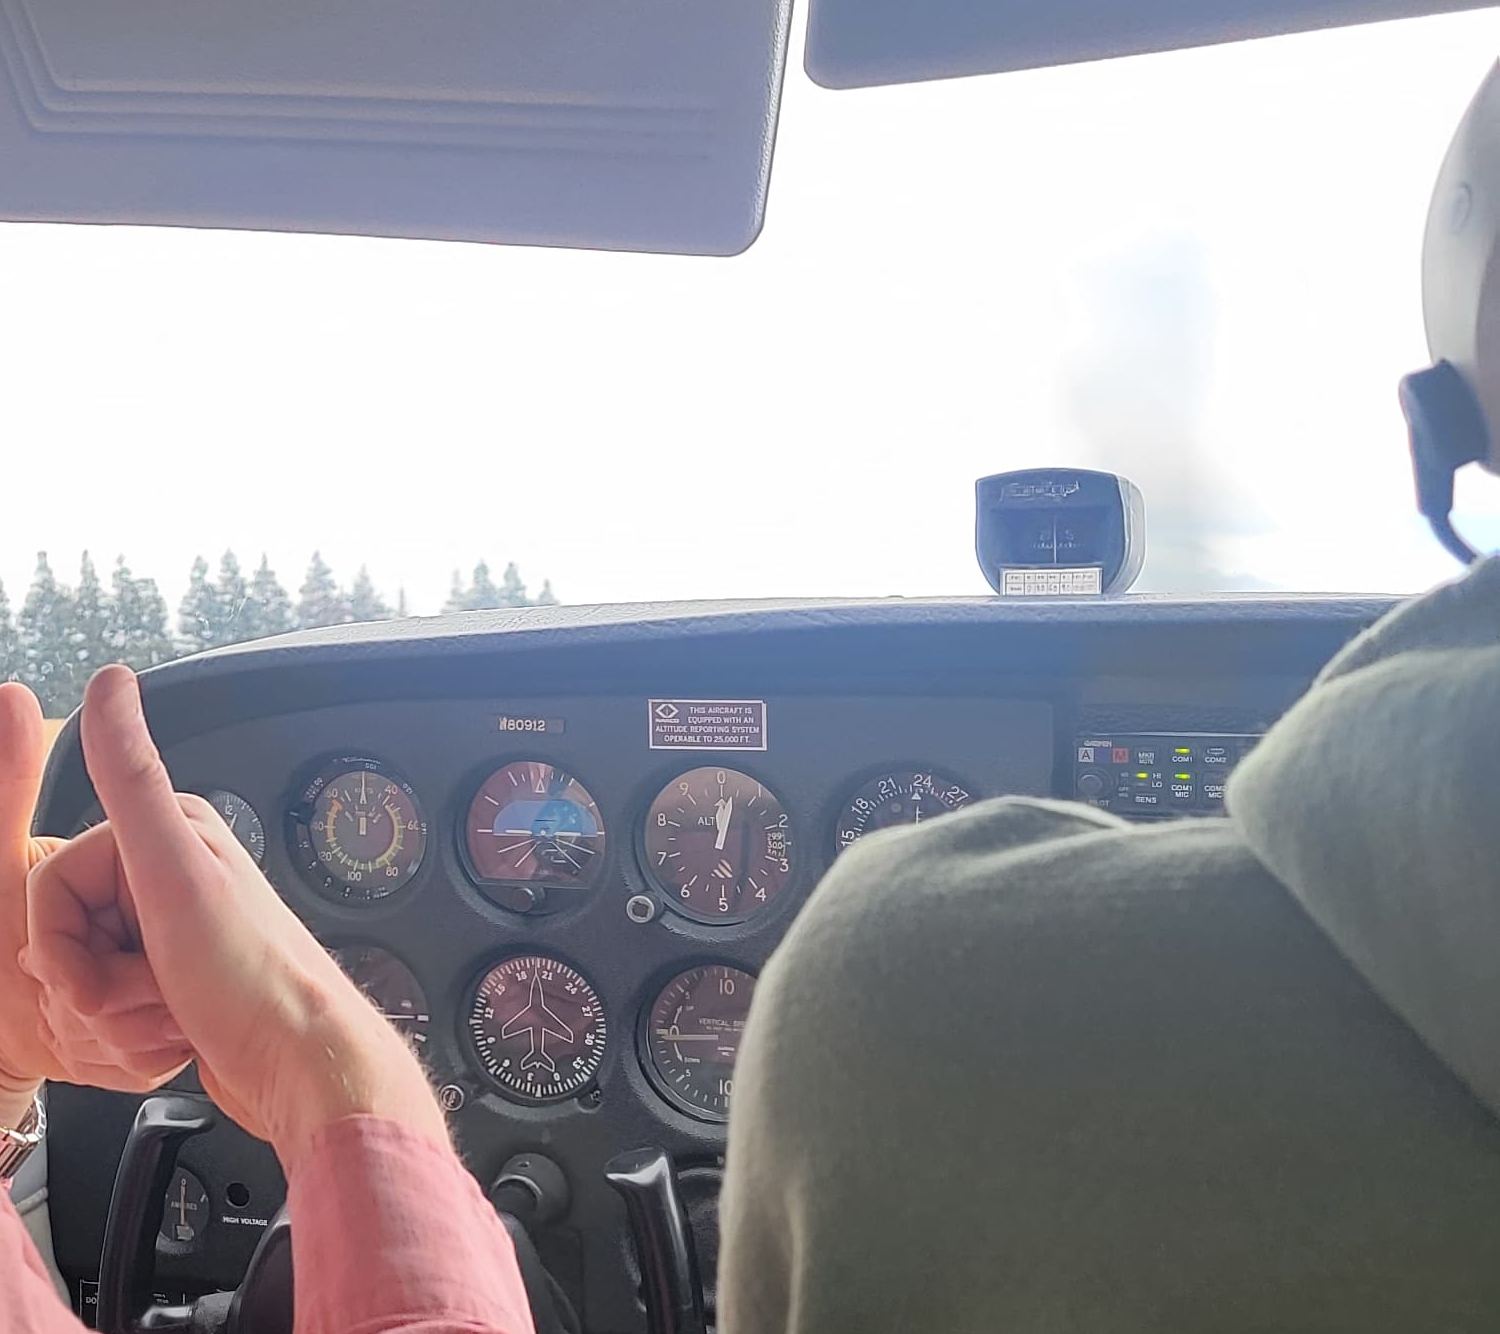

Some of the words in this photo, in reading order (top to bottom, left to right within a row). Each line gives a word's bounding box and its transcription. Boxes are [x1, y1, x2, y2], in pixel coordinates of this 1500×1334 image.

[690, 706, 706, 714] THIS
[708, 706, 742, 714] AIRCRAFT
[687, 716, 722, 725] EQUIPPED
[655, 725, 688, 733] ALTITUDE
[731, 726, 760, 734] SYSTEM
[663, 734, 701, 742] OPERABLE
[703, 735, 712, 743] TO
[1172, 755, 1193, 763] COM1
[716, 770, 727, 784] 0
[913, 774, 933, 788] 24
[383, 784, 398, 795] 40
[678, 782, 689, 796] 9
[878, 777, 897, 794] 21
[1152, 780, 1163, 788] LO
[1171, 784, 1193, 792] COM1
[947, 785, 969, 802] 27
[1135, 796, 1157, 804] SENS
[851, 797, 869, 815] 18
[407, 819, 419, 831] 60
[657, 812, 667, 827] 8
[697, 816, 715, 826] ALT
[778, 814, 789, 828] 2
[840, 829, 855, 848] 15
[657, 851, 667, 865] 7
[386, 866, 399, 877] 80
[779, 858, 789, 872] 3
[347, 871, 362, 881] 100
[680, 884, 690, 898] 6
[755, 887, 767, 902] 4
[718, 897, 729, 911] 5
[515, 970, 528, 982] 18
[541, 970, 554, 981] 21
[494, 983, 506, 996] 15
[564, 981, 578, 995] 24
[719, 978, 735, 995] 10
[484, 1007, 495, 1019] 12
[584, 1032, 595, 1046] 30
[572, 1056, 585, 1069] 33
[719, 1079, 733, 1096] 10
[222, 1216, 240, 1225] HIGH
[241, 1217, 269, 1226] VOLTAGE
